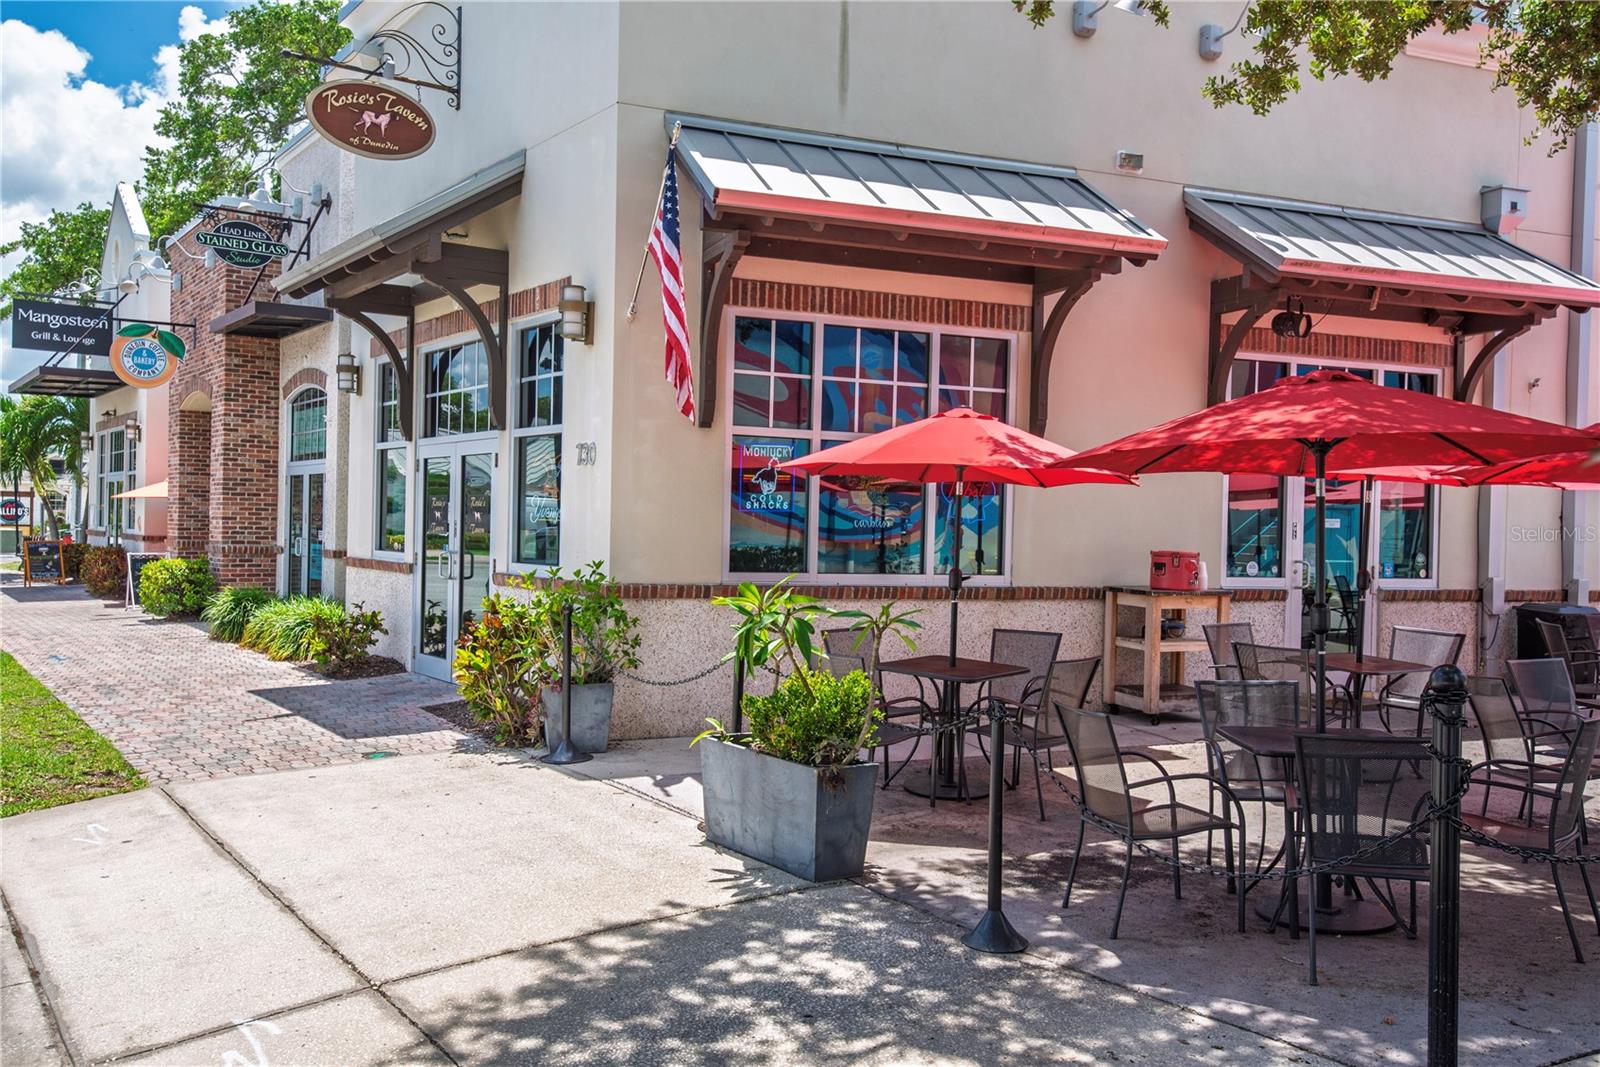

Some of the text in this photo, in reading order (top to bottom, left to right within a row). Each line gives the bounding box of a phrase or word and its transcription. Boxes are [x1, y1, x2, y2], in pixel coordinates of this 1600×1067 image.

[322, 89, 428, 131] Rosie's Tavern
[349, 136, 399, 151] of Dunedin
[220, 225, 267, 240] LEAD LINES
[198, 232, 287, 255] STAINED GLASS
[225, 250, 261, 264] Studio
[18, 308, 109, 329] Mangosteen
[31, 331, 51, 341] Grill
[52, 333, 61, 341] &
[575, 442, 597, 467] 730
[750, 494, 784, 502] COLD
